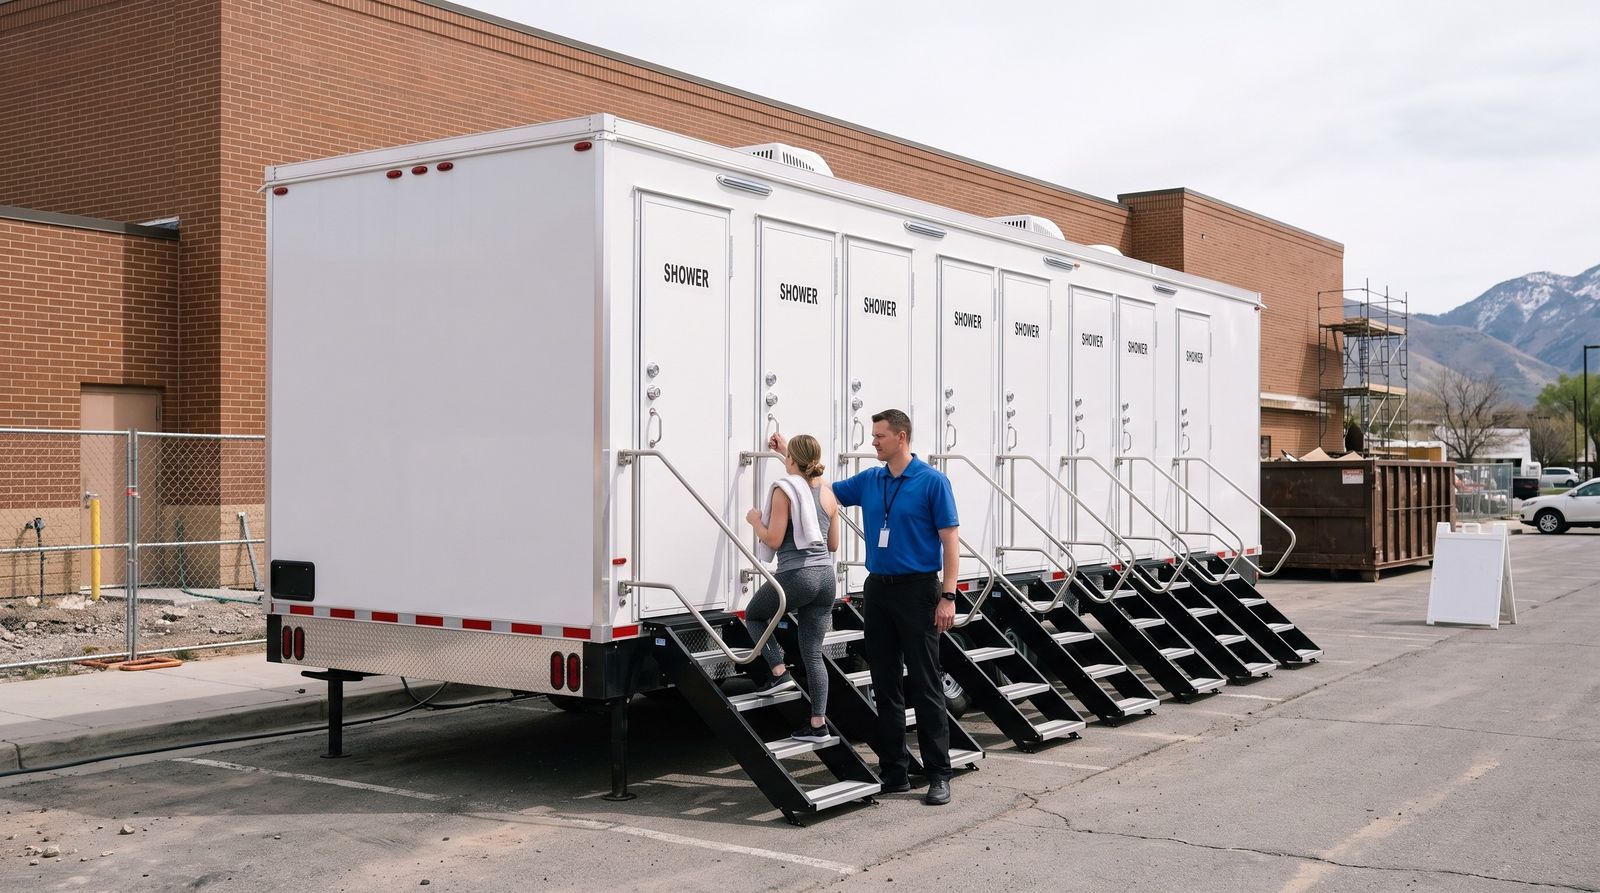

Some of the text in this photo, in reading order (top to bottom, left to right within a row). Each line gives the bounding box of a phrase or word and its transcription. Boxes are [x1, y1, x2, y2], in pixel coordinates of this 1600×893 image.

[664, 263, 709, 288] SHOWER
[779, 283, 818, 305] SHOWER
[863, 297, 897, 318] SHOWER
[954, 311, 982, 329] SHOWER
[1015, 322, 1040, 338] SHOWER
[1081, 333, 1104, 348] SHOWER
[1127, 341, 1148, 355] SHOWER
[1186, 350, 1203, 364] SHOWER
